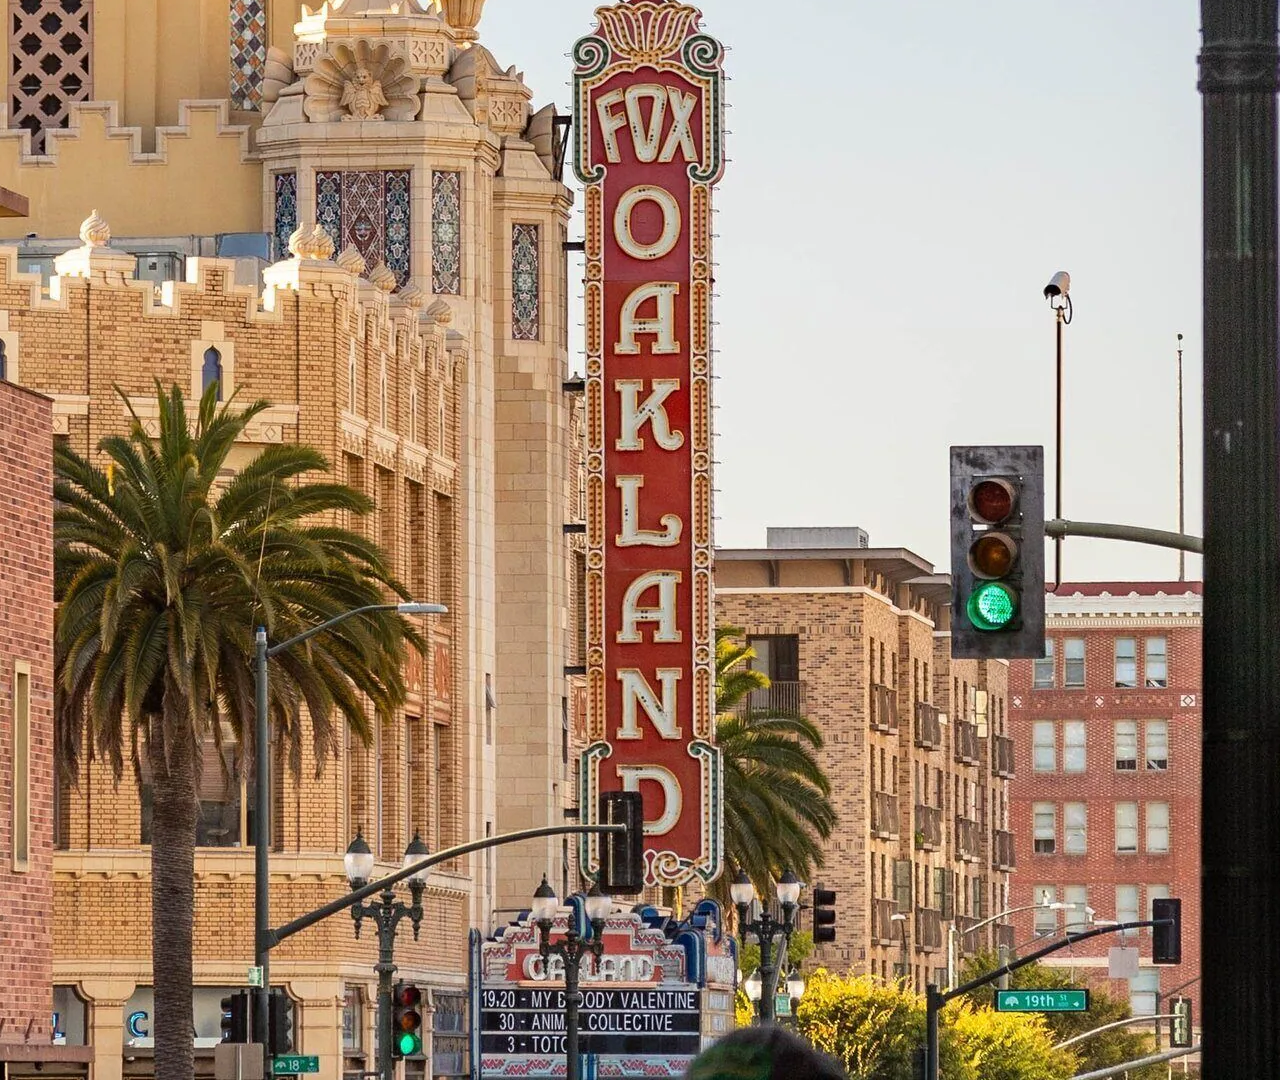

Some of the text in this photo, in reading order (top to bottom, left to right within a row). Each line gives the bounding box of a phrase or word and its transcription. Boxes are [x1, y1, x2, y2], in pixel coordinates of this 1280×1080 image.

[596, 83, 698, 163] FOX
[614, 184, 684, 837] OAKLAND
[531, 991, 550, 1008] MY
[557, 992, 615, 1009] BOODY
[620, 992, 695, 1009] VALENTINE
[1025, 994, 1054, 1008] 19th
[499, 1013, 515, 1031] 30
[589, 1014, 672, 1031] COLLECTIVE
[507, 1037, 515, 1053] 3
[531, 1037, 568, 1053] TOTO
